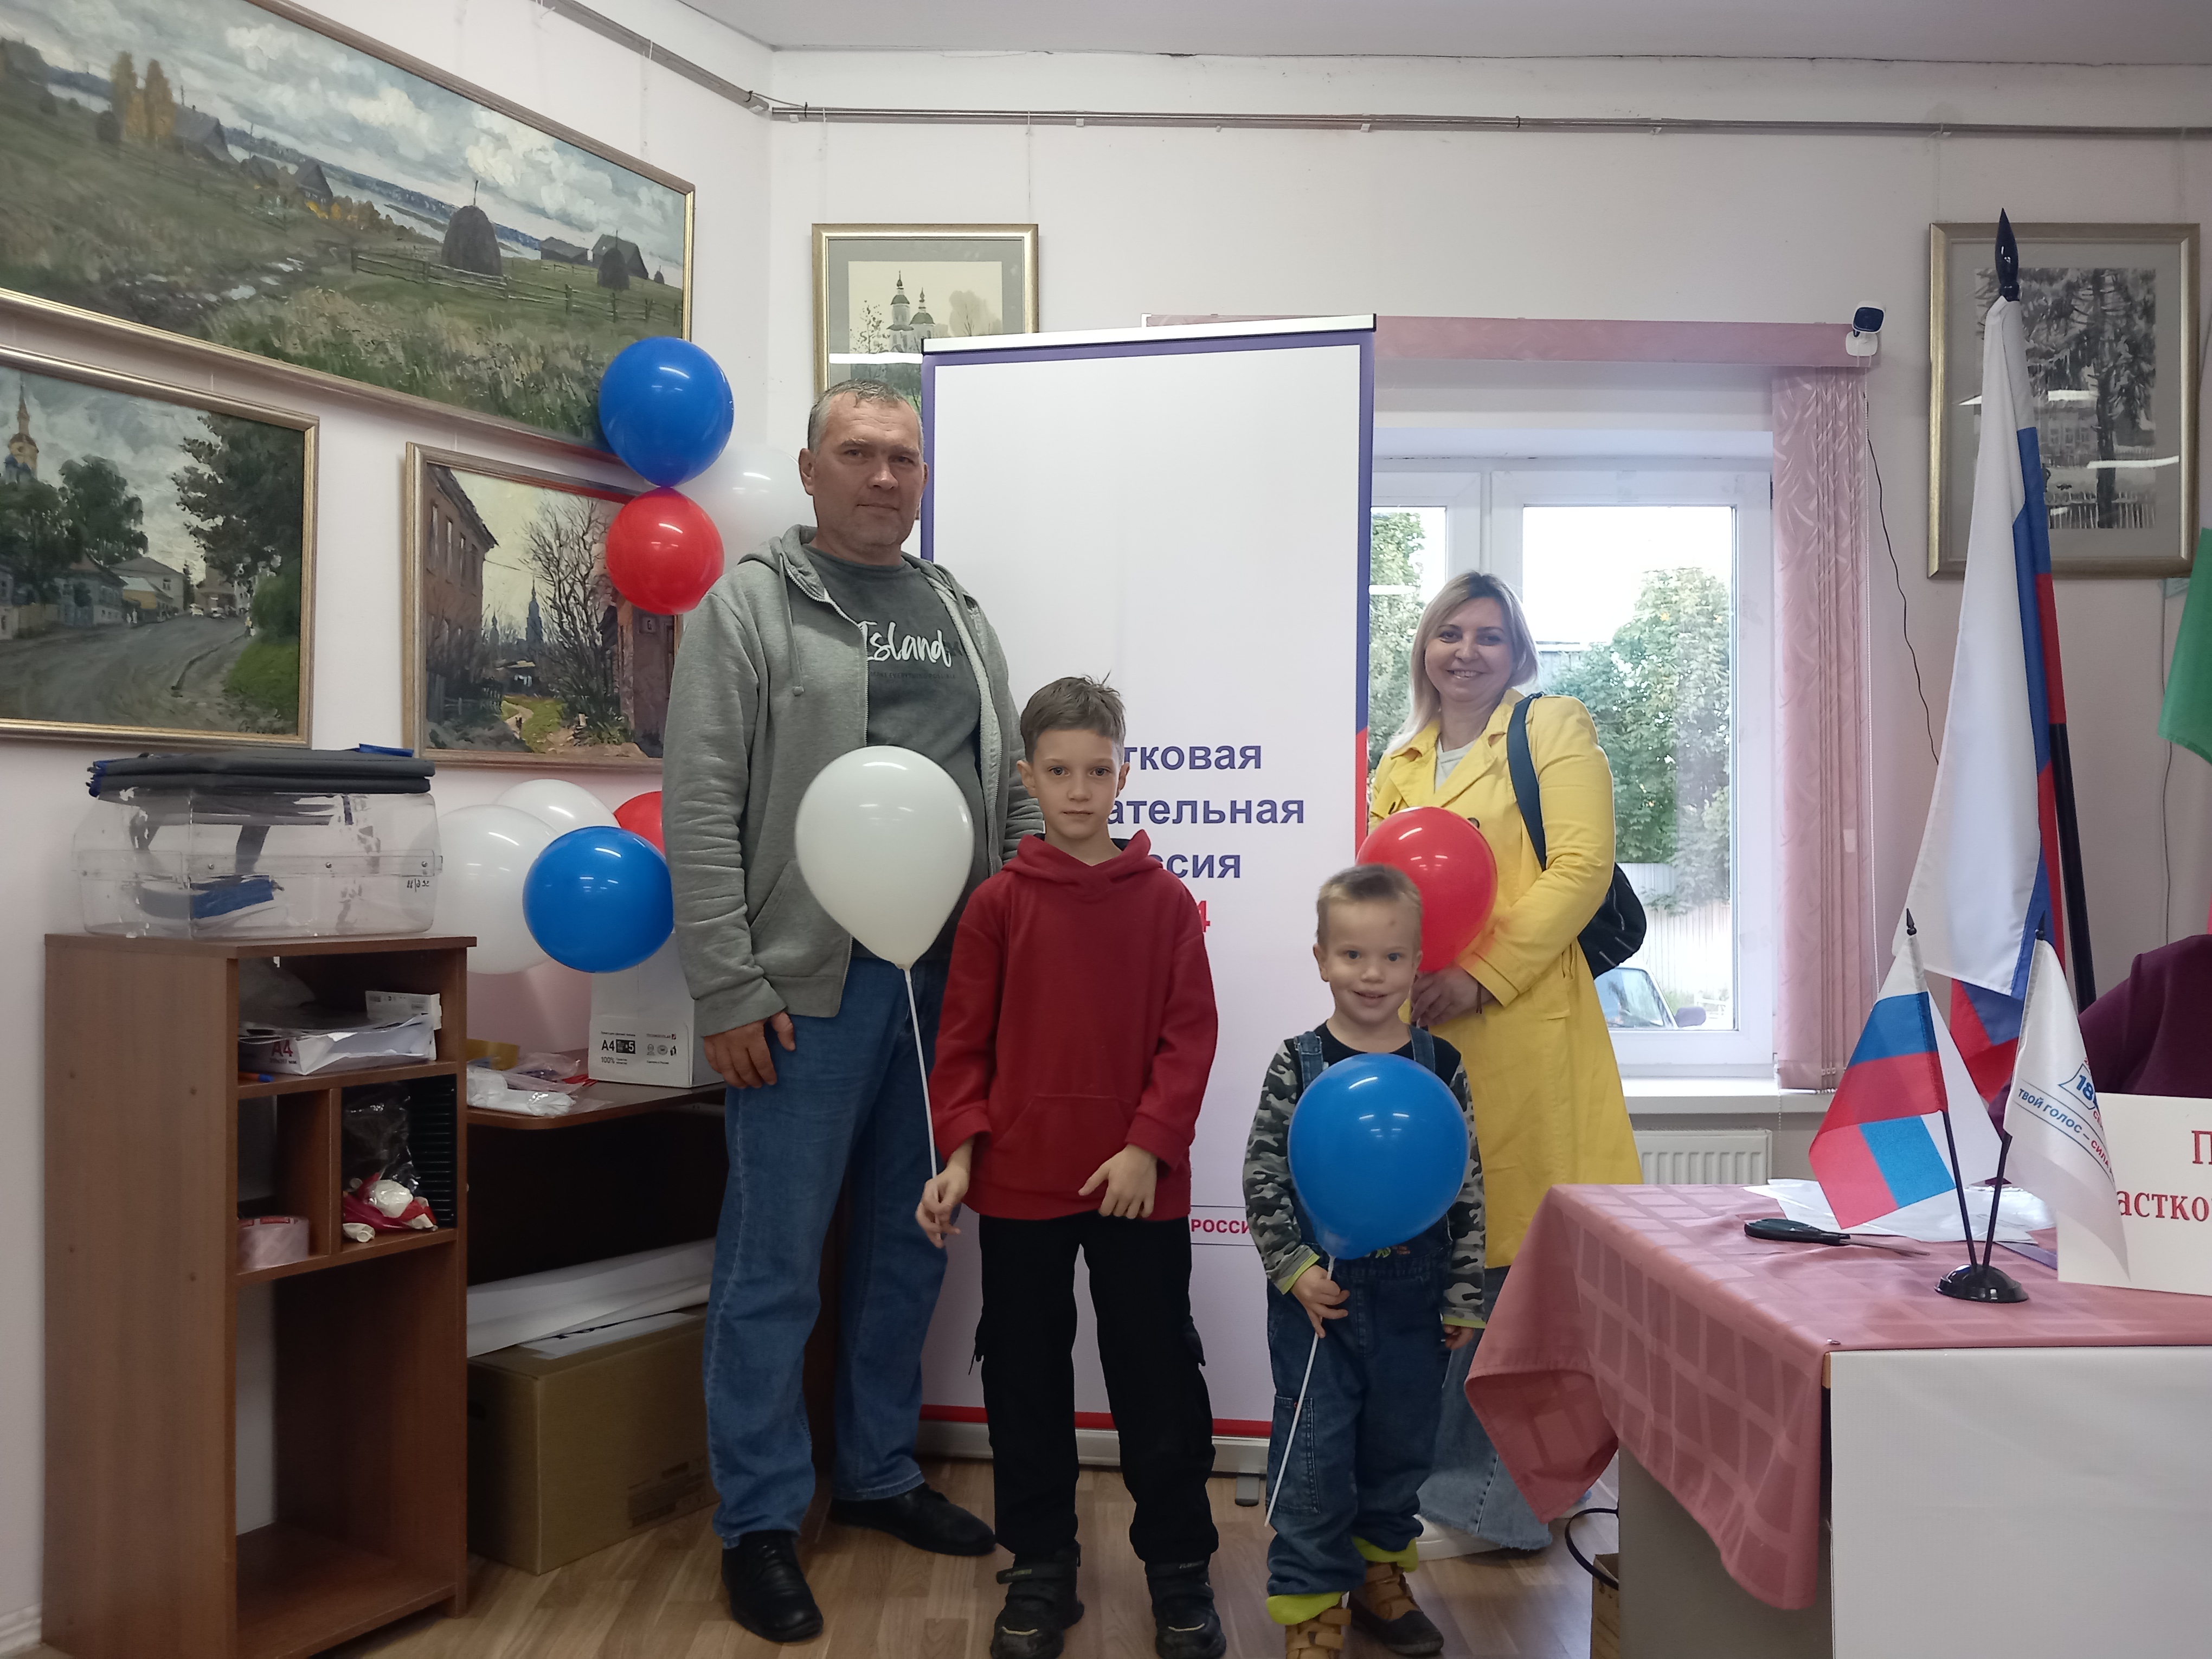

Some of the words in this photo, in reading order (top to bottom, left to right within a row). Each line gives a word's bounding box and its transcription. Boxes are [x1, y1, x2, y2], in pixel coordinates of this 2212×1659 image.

[272, 1039, 293, 1057] A4
[601, 1039, 615, 1051] A4
[601, 1056, 615, 1064] 100%
[2017, 1088, 2044, 1108] ТВОЙ
[2043, 1104, 2082, 1133] ГОЛОС
